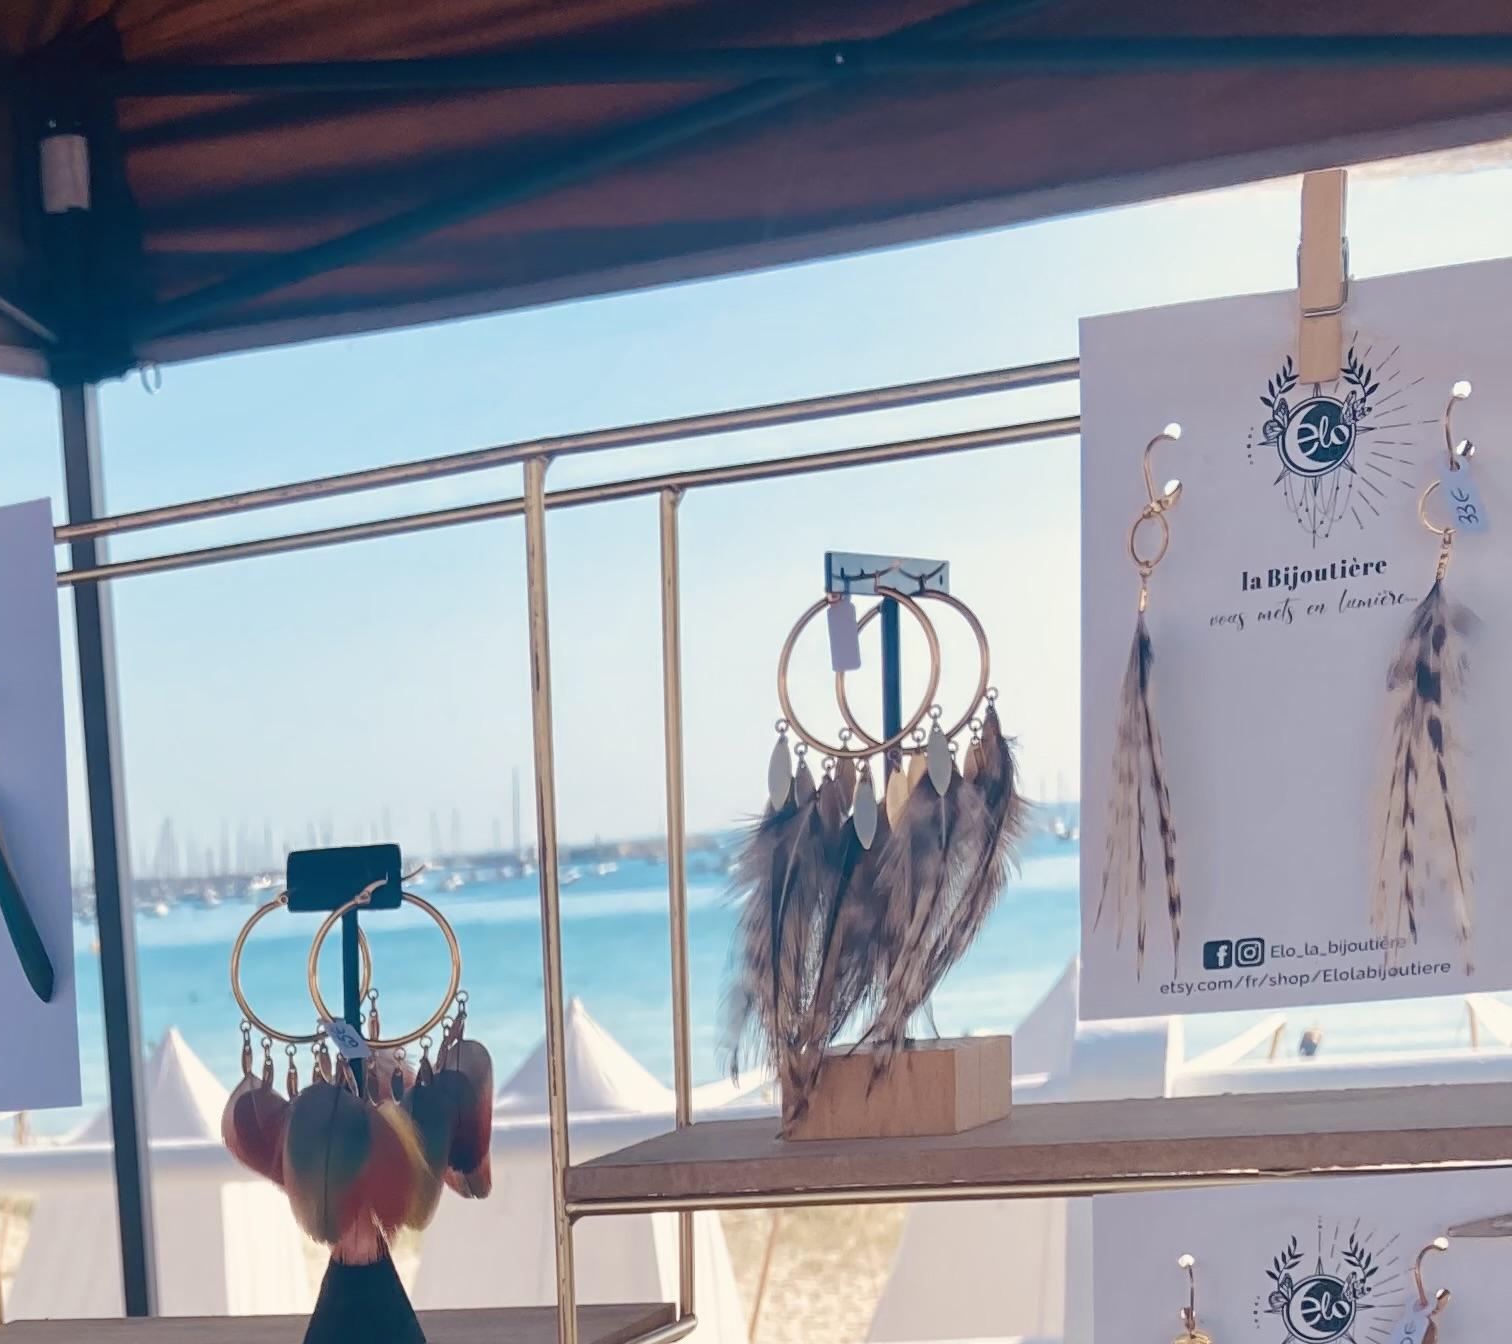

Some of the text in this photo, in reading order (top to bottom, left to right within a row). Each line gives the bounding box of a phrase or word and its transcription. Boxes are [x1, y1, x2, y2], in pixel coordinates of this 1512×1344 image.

[1450, 488, 1478, 524] 33€
[1241, 557, 1388, 592] la Bijoutière
[1159, 959, 1452, 997] etsy.com/fr/shop/Elolabijoutiere
